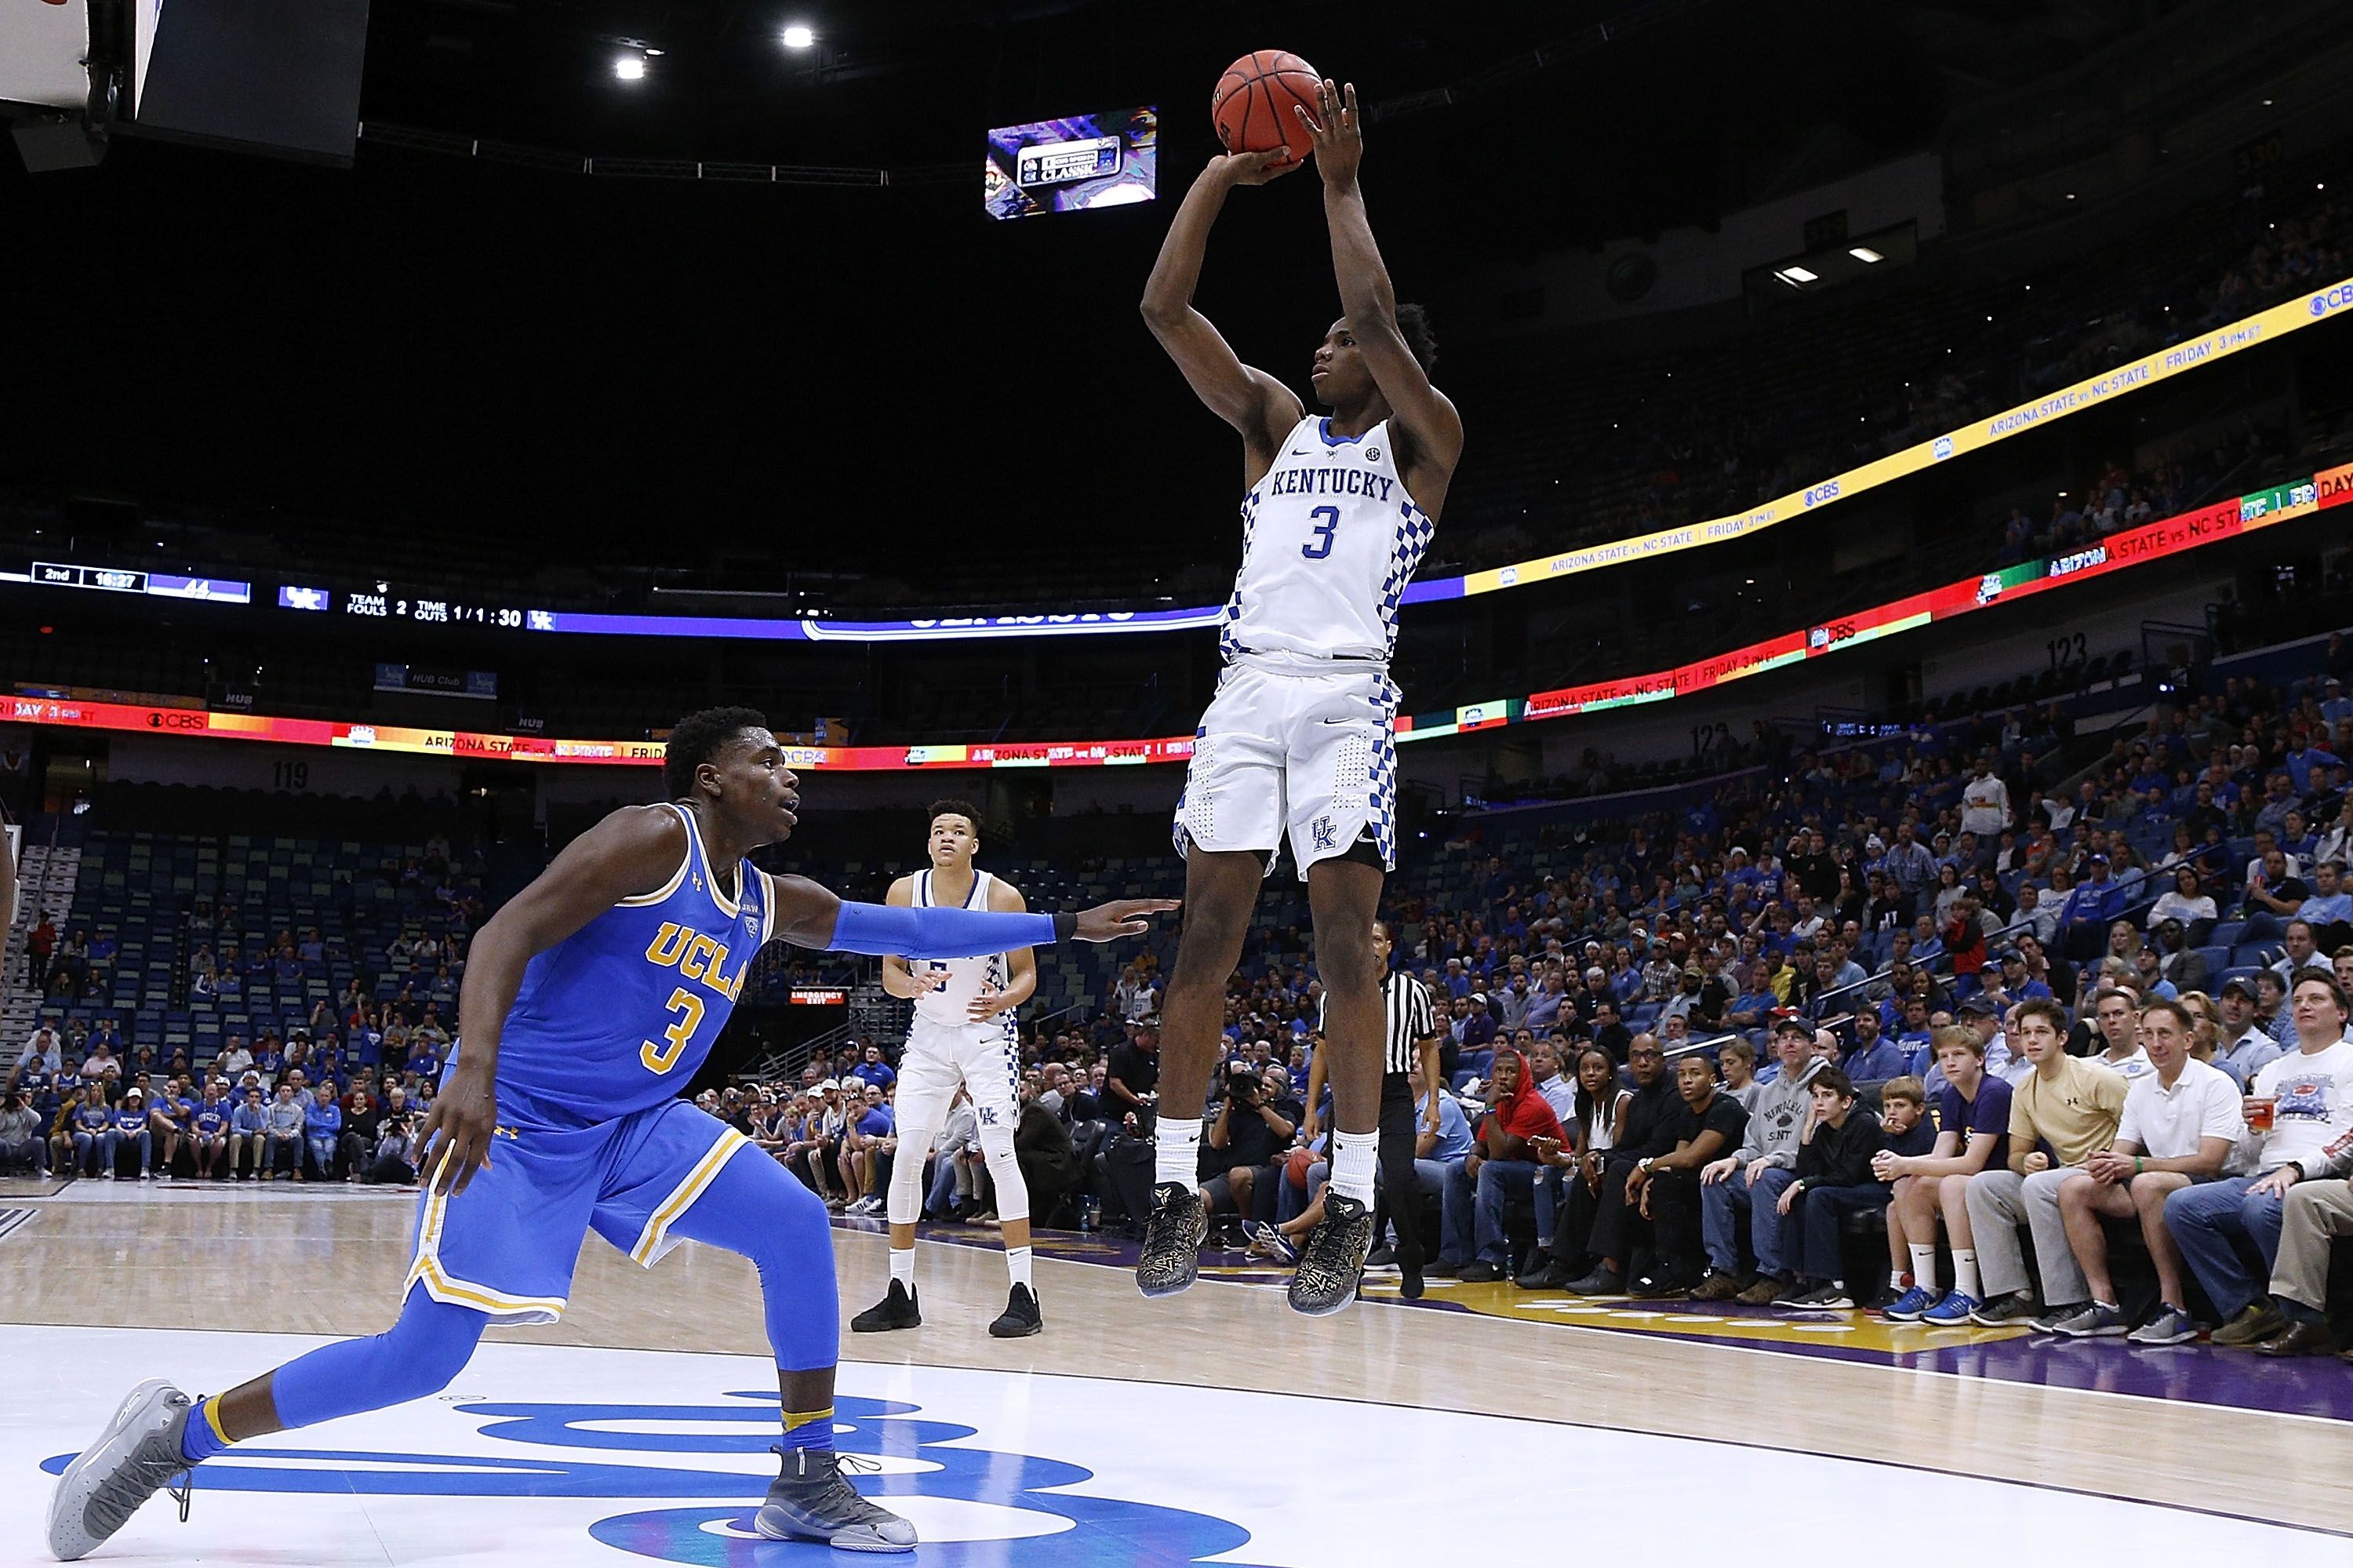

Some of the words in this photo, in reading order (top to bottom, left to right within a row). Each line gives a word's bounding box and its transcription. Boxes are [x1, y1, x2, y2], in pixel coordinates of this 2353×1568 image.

[1041, 163, 1097, 181] CLASSIC
[2327, 285, 2353, 307] CB
[1990, 410, 2038, 436] ARIZONA
[2042, 394, 2075, 417] STATE
[2093, 381, 2109, 396] NC
[2112, 366, 2149, 390] STATE
[2166, 342, 2212, 369] FRIDAY
[2219, 335, 2227, 349] 3
[2230, 331, 2247, 346] PM
[2249, 325, 2262, 340] ET
[1271, 468, 1394, 503] KENTUCKY
[1815, 482, 1839, 502] CBS
[1301, 505, 1340, 561] 3
[2049, 548, 2115, 577] ARIZONA
[2120, 529, 2166, 558] STATE
[2189, 517, 2210, 538] NC
[2216, 498, 2268, 529] STATE
[1551, 555, 1595, 573] ARIZONA
[1598, 547, 1629, 562] STATE
[1643, 539, 1657, 551] NC
[1660, 531, 1693, 548] STATE
[1707, 520, 1745, 538] FRIDAY
[1748, 516, 1755, 526] 3
[1755, 515, 1766, 524] PM
[45, 569, 70, 581] 2nd
[95, 572, 136, 588] 16:27
[350, 593, 385, 606] TEAM
[395, 600, 407, 615] 2
[416, 600, 446, 612] TIME
[347, 602, 387, 617] FOULS
[414, 609, 448, 622] OUTS
[413, 673, 435, 684] HUB
[438, 675, 460, 686] Club
[1524, 695, 1578, 716] ARIZONA
[1581, 688, 1617, 703] STATE
[1635, 682, 1652, 694] NC
[1657, 672, 1689, 690] STATE
[1704, 659, 1738, 681] FRIDAY
[1744, 658, 1750, 669] 3
[1752, 654, 1764, 666] PM
[226, 693, 253, 704] HUB
[0, 701, 42, 717] RIDAY
[49, 706, 57, 718] 3
[166, 715, 204, 729] CBS
[518, 717, 544, 728] HUB
[425, 736, 486, 751] ARIZONA
[489, 740, 530, 753] STATE
[631, 748, 667, 759] FRIDA
[973, 748, 1030, 762] ARIZONA
[1113, 744, 1151, 757] STATE
[1166, 741, 1194, 755] FRID
[275, 761, 308, 788] 119
[645, 921, 747, 1006] UCLA
[639, 986, 706, 1076] 3
